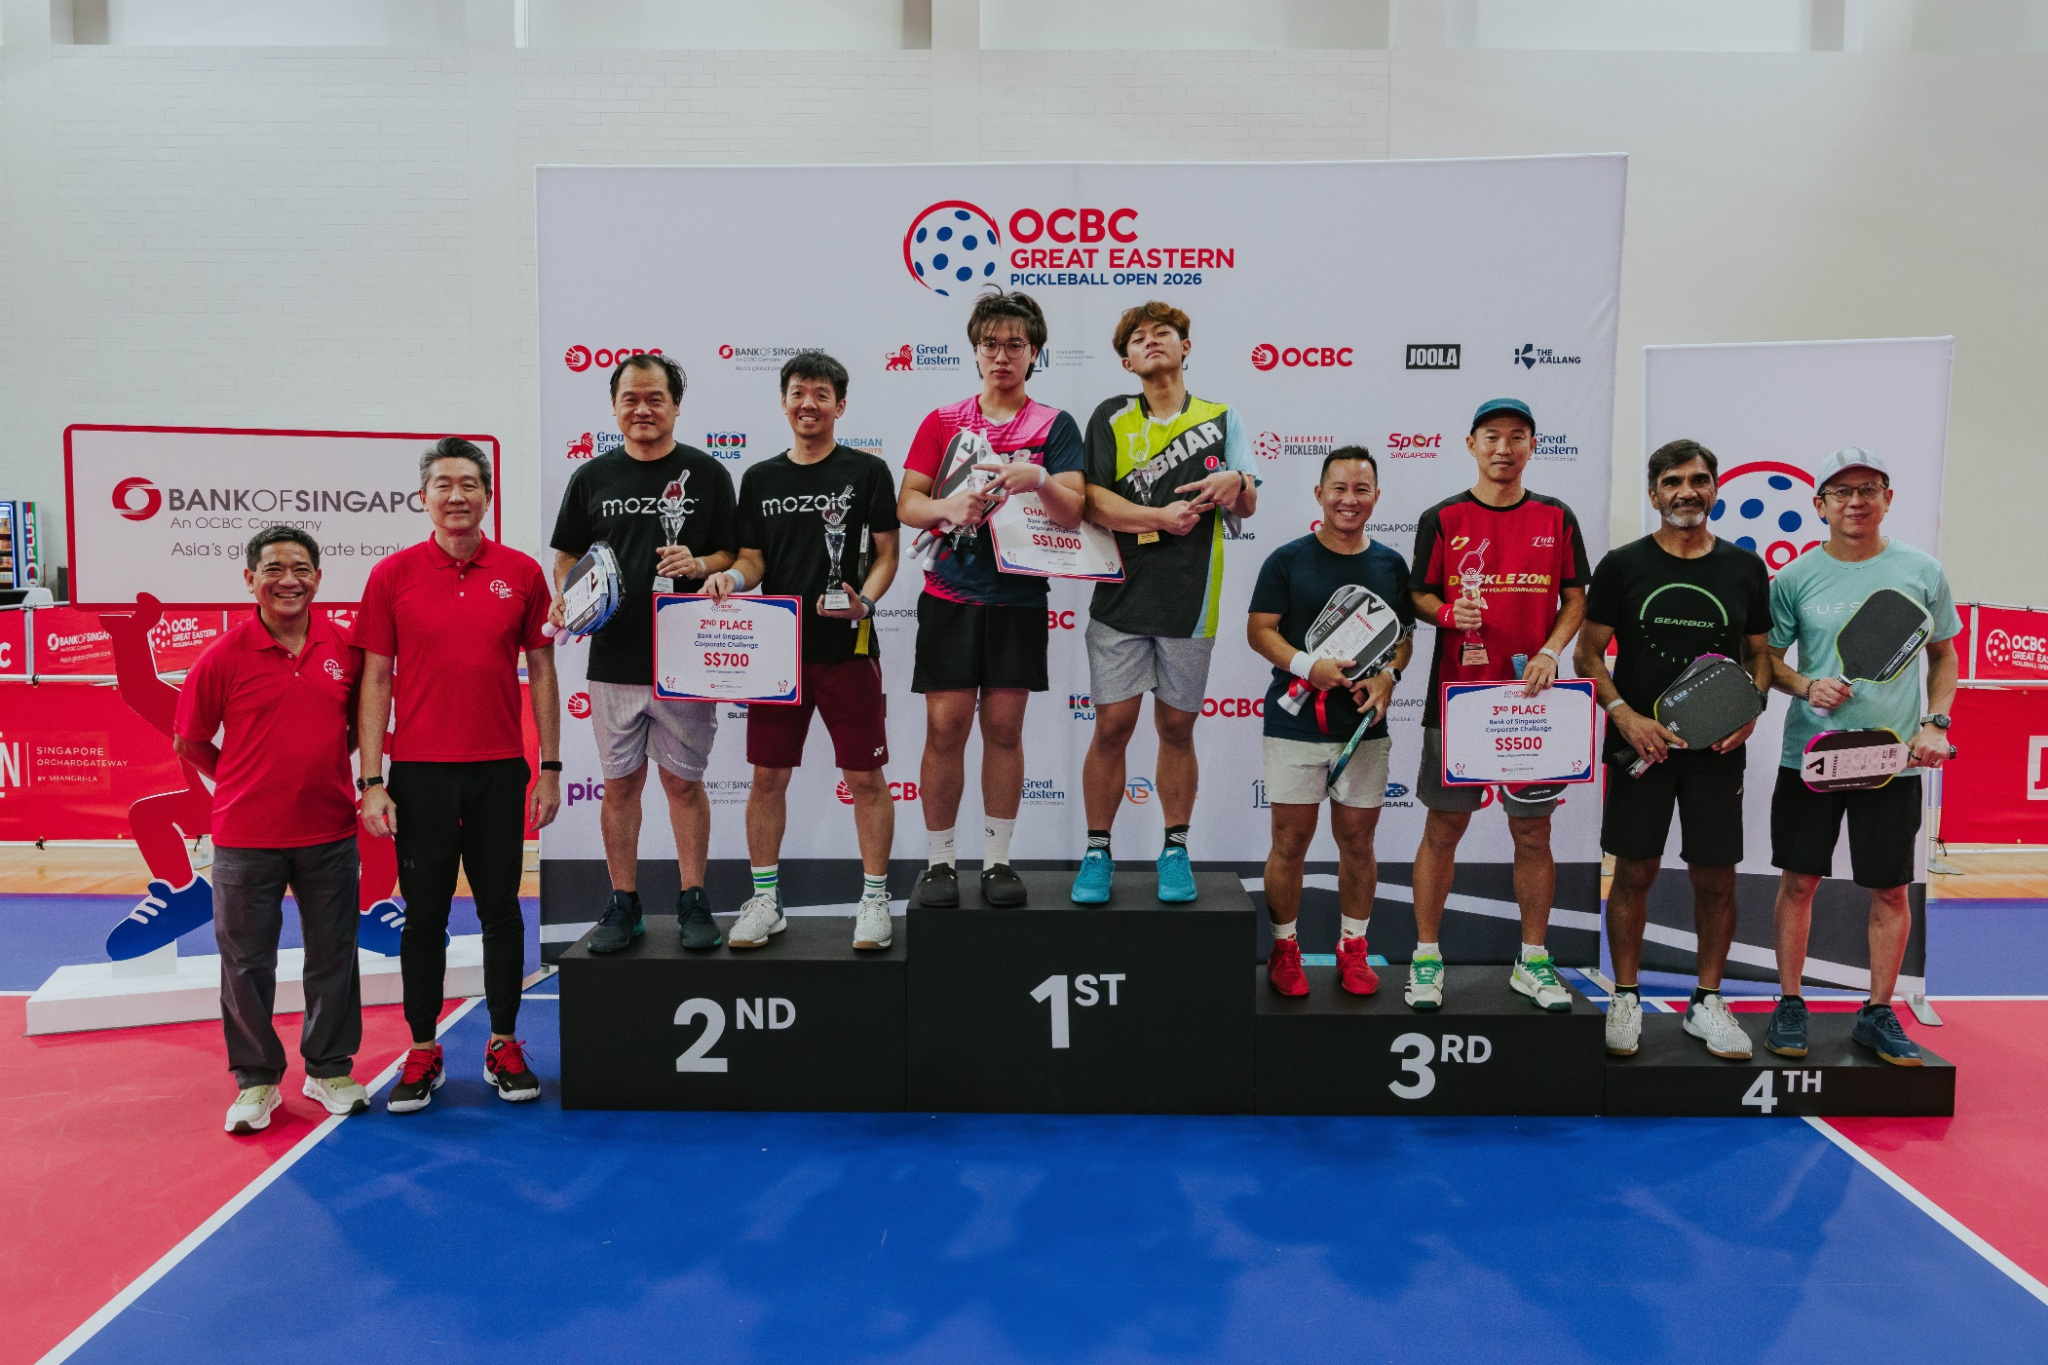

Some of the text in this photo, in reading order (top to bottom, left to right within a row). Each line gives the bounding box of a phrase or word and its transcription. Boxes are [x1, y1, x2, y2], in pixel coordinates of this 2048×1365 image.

[1009, 208, 1139, 244] OCBC
[1010, 248, 1234, 269] GREAT EASTERN
[1010, 273, 1203, 285] PICKLEBALL OPEN 2026
[916, 344, 948, 354] Great
[916, 355, 960, 366] Eastern
[1282, 347, 1354, 367] OCBC
[1408, 348, 1458, 366] JOOLA
[1539, 356, 1582, 365] KALLANG
[837, 437, 883, 446] TAISHAN
[1284, 435, 1335, 443] SINGAPORE
[1387, 432, 1443, 450] Sport
[711, 451, 741, 459] PLUS
[1534, 444, 1579, 455] Eastern
[1023, 506, 1048, 517] CHA
[170, 517, 191, 529] An
[195, 517, 243, 529] OCBC
[25, 512, 36, 560] PLUS
[171, 542, 222, 556] Asia's
[172, 617, 199, 633] OCBC
[700, 619, 753, 631] 2ND PLACE
[1653, 617, 1716, 629] GEARBOX
[172, 629, 217, 642] GREAT EASTERN
[694, 640, 759, 649] Corporate Challenge
[2011, 634, 2047, 653] OCBC
[703, 651, 750, 668] S$700
[2011, 650, 2035, 660] GREAT
[2011, 660, 2037, 669] PICKLEBALL
[1492, 704, 1547, 716] 3RD PLACE
[1514, 717, 1548, 725] Singapore
[1520, 725, 1553, 733] Challenge
[1495, 736, 1543, 752] S$500
[36, 746, 104, 756] SINGAPORE
[36, 758, 128, 767] ORCHARDGATEWAY
[1022, 779, 1053, 789] Great
[1022, 790, 1065, 799] Eastern
[1029, 972, 1127, 1049] 1ST
[673, 997, 797, 1073] 2ND
[1387, 1032, 1493, 1100] 3RD
[1741, 1069, 1822, 1114] 4TH
